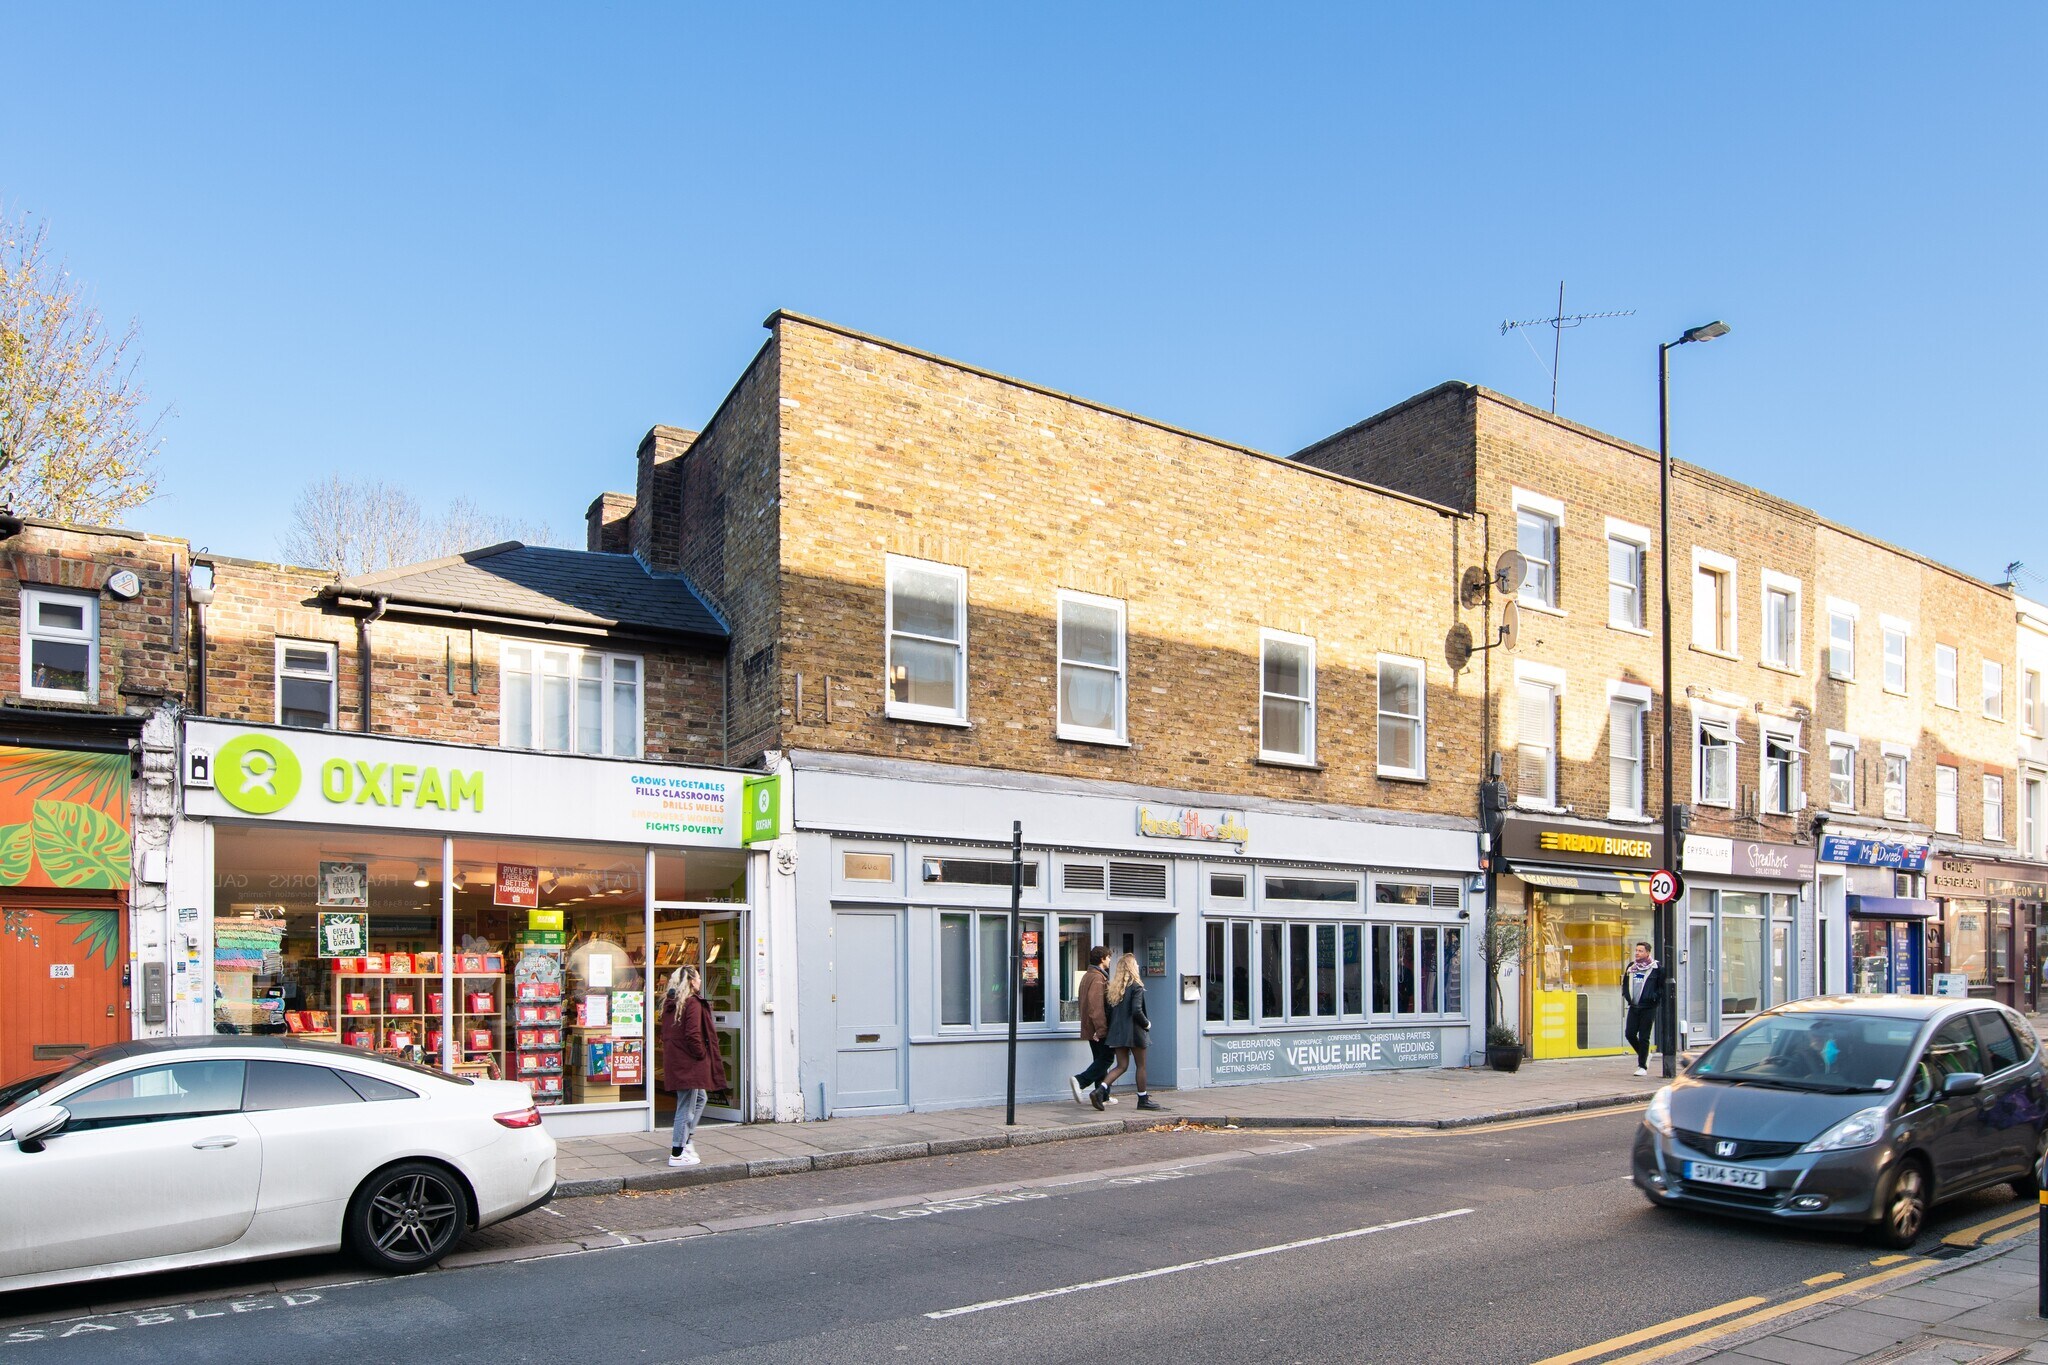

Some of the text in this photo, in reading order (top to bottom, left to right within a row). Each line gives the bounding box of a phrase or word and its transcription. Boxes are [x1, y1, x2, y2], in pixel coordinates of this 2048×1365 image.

[322, 757, 484, 813] OXFAM
[631, 775, 725, 792] GROWS VEGETABLES
[635, 787, 725, 803] FILLS CLASSROOMS
[663, 800, 724, 813] DRILLS WELLS
[632, 810, 724, 825] EMPOWERS WOMEN
[646, 822, 724, 835] FIGHTS POVERTY
[755, 818, 772, 831] OXFAM
[1141, 806, 1249, 854] kiss the sky
[1563, 834, 1652, 858] READYBURGER
[1687, 846, 1729, 858] CRYSTAL LIFE
[1747, 844, 1789, 869] Streathers
[1860, 844, 1872, 860] Mr
[1877, 845, 1901, 863] Dweeb
[1755, 867, 1781, 876] SOLICITORS
[1944, 861, 1975, 873] CHINESE
[502, 872, 528, 880] THERE'S
[499, 885, 535, 894] TOMORROW
[505, 879, 530, 887] BETTER
[1652, 879, 1671, 895] 20
[2001, 886, 2032, 897] DRAGON
[333, 933, 355, 941] LITTLE
[1369, 1031, 1431, 1042] CHRISTMAS PARTIES
[1227, 1038, 1281, 1049] CELEBRATIONS
[1393, 1041, 1435, 1053] WEDDINGS
[635, 1055, 640, 1063] 2
[1221, 1050, 1275, 1064] BIRTHDAYS
[1287, 1043, 1381, 1066] VENUE HIRE
[1399, 1054, 1418, 1062] OFFICE
[1216, 1063, 1271, 1074] MEETING SPACES
[1302, 1062, 1367, 1072] www.kisstheskybar.com
[1729, 1170, 1759, 1185] SXZ
[871, 1171, 1196, 1220] LOADING ONLY
[5, 1294, 322, 1343] SABLED
